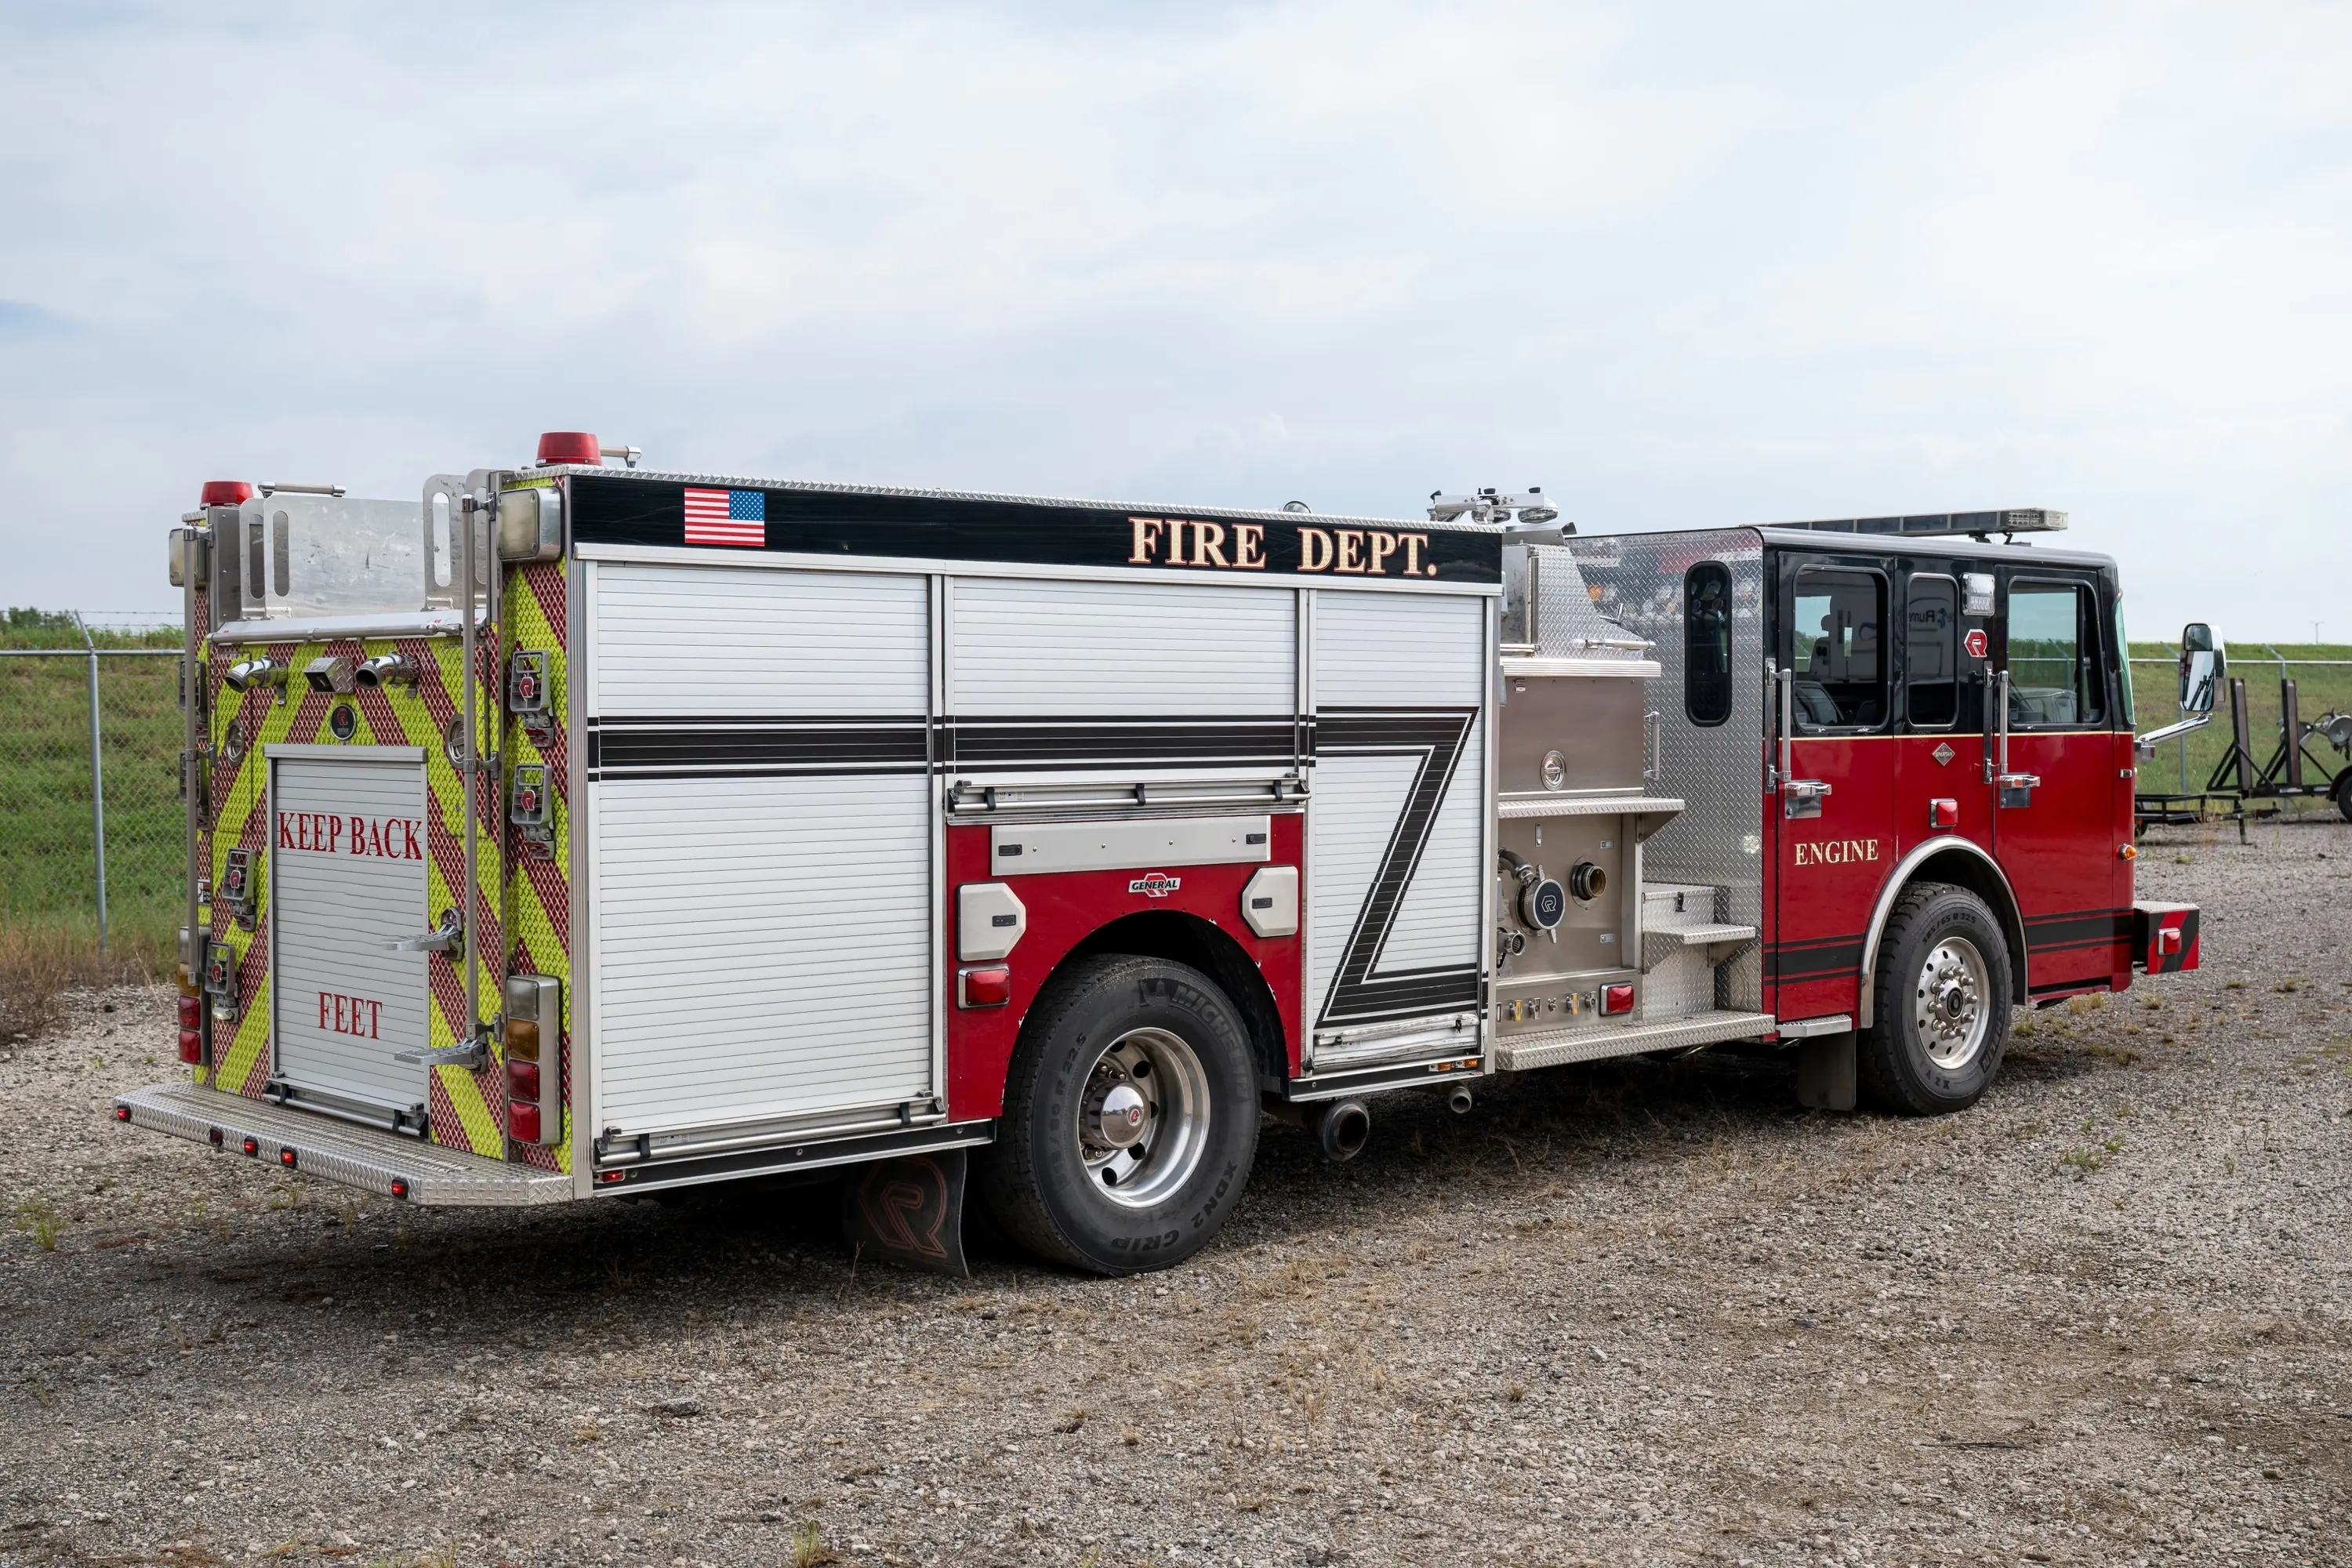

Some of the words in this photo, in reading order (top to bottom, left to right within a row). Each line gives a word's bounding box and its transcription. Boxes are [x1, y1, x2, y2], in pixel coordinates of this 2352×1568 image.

[1127, 516, 1267, 569] FIRE
[1296, 526, 1438, 578] DEPT.
[278, 811, 343, 853] KEEP
[349, 816, 423, 860] BACK
[1794, 839, 1879, 866] ENGINE
[1131, 880, 1178, 891] GENERAL
[318, 991, 383, 1040] FEET
[1171, 985, 1250, 1099] MICHELIN
[1110, 1229, 1180, 1252] GRIP
